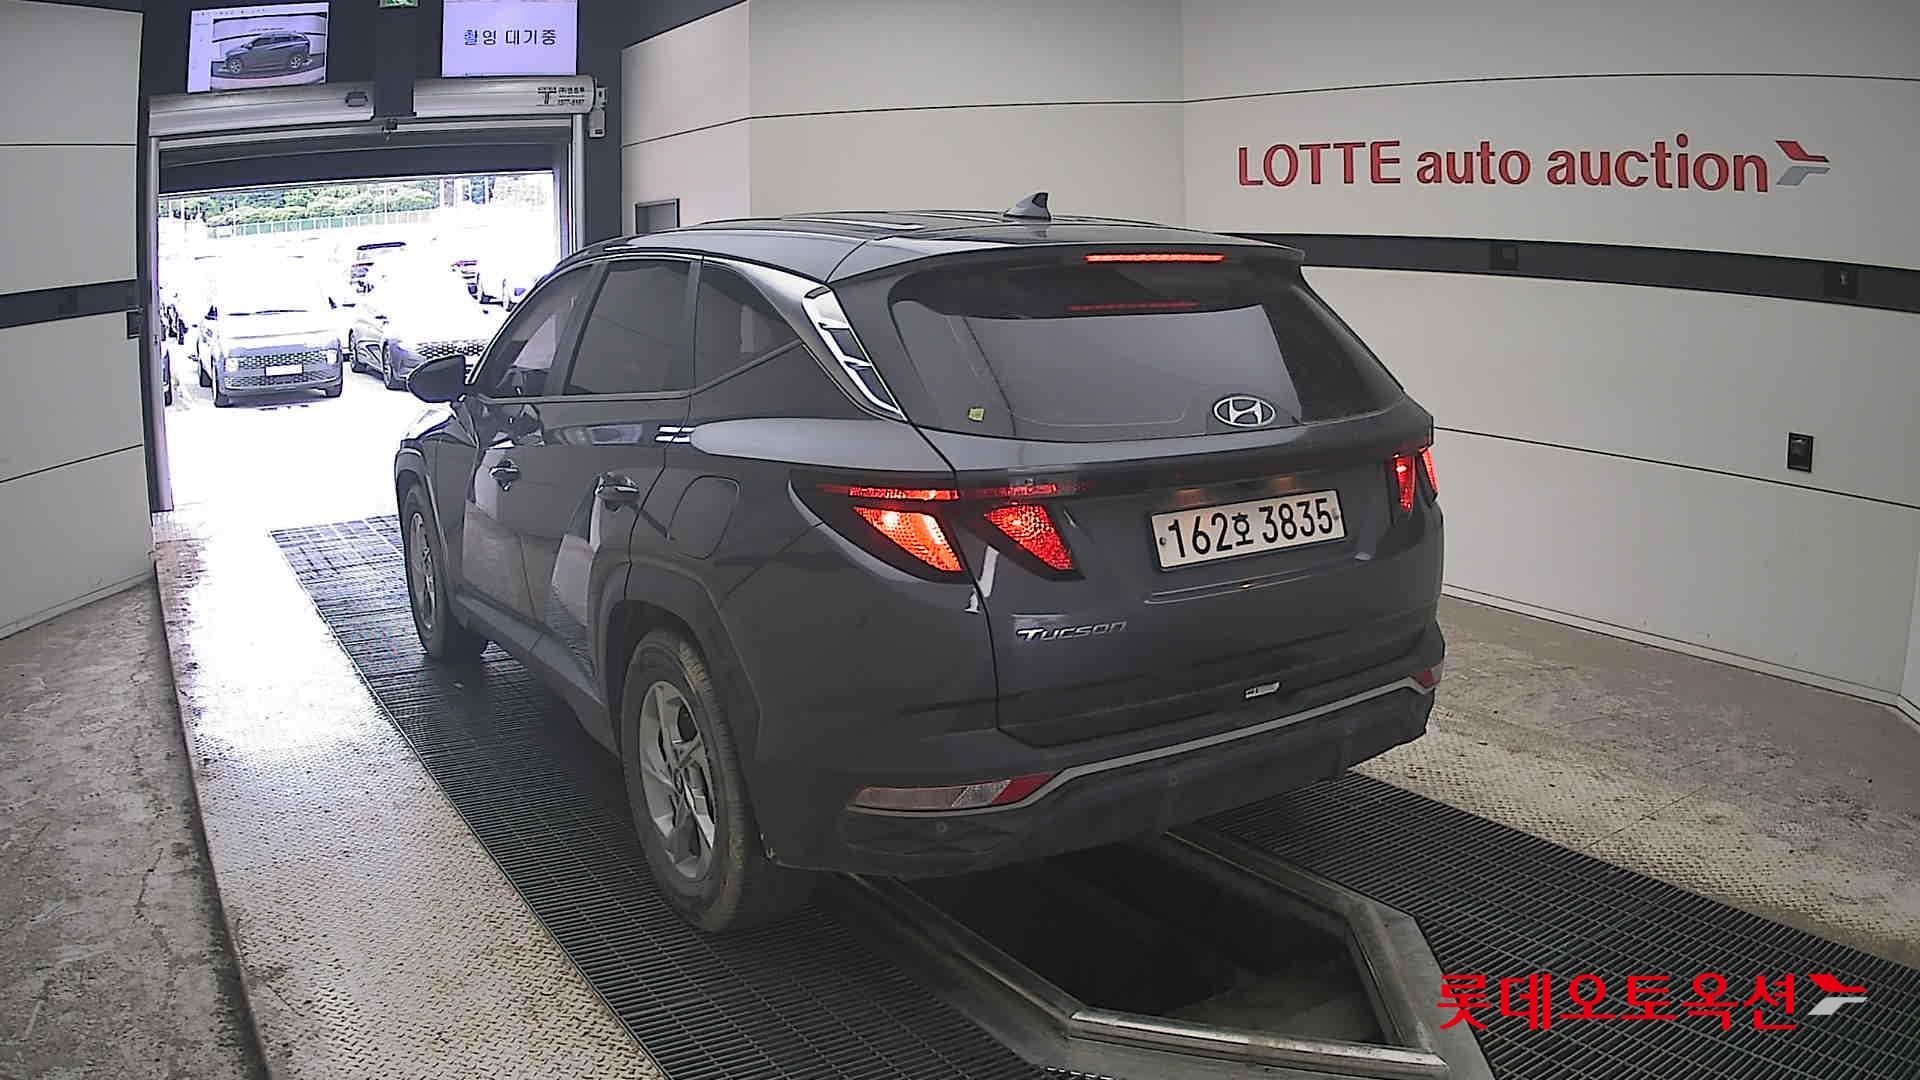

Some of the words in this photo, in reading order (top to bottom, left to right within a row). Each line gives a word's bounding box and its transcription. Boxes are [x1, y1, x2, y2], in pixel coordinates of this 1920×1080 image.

[505, 29, 557, 46] 대기중
[1238, 140, 1401, 187] LOTTE
[1416, 140, 1531, 186] auto
[1546, 133, 1769, 193] auction
[1167, 512, 1254, 558] 162호
[1258, 498, 1334, 544] 3835
